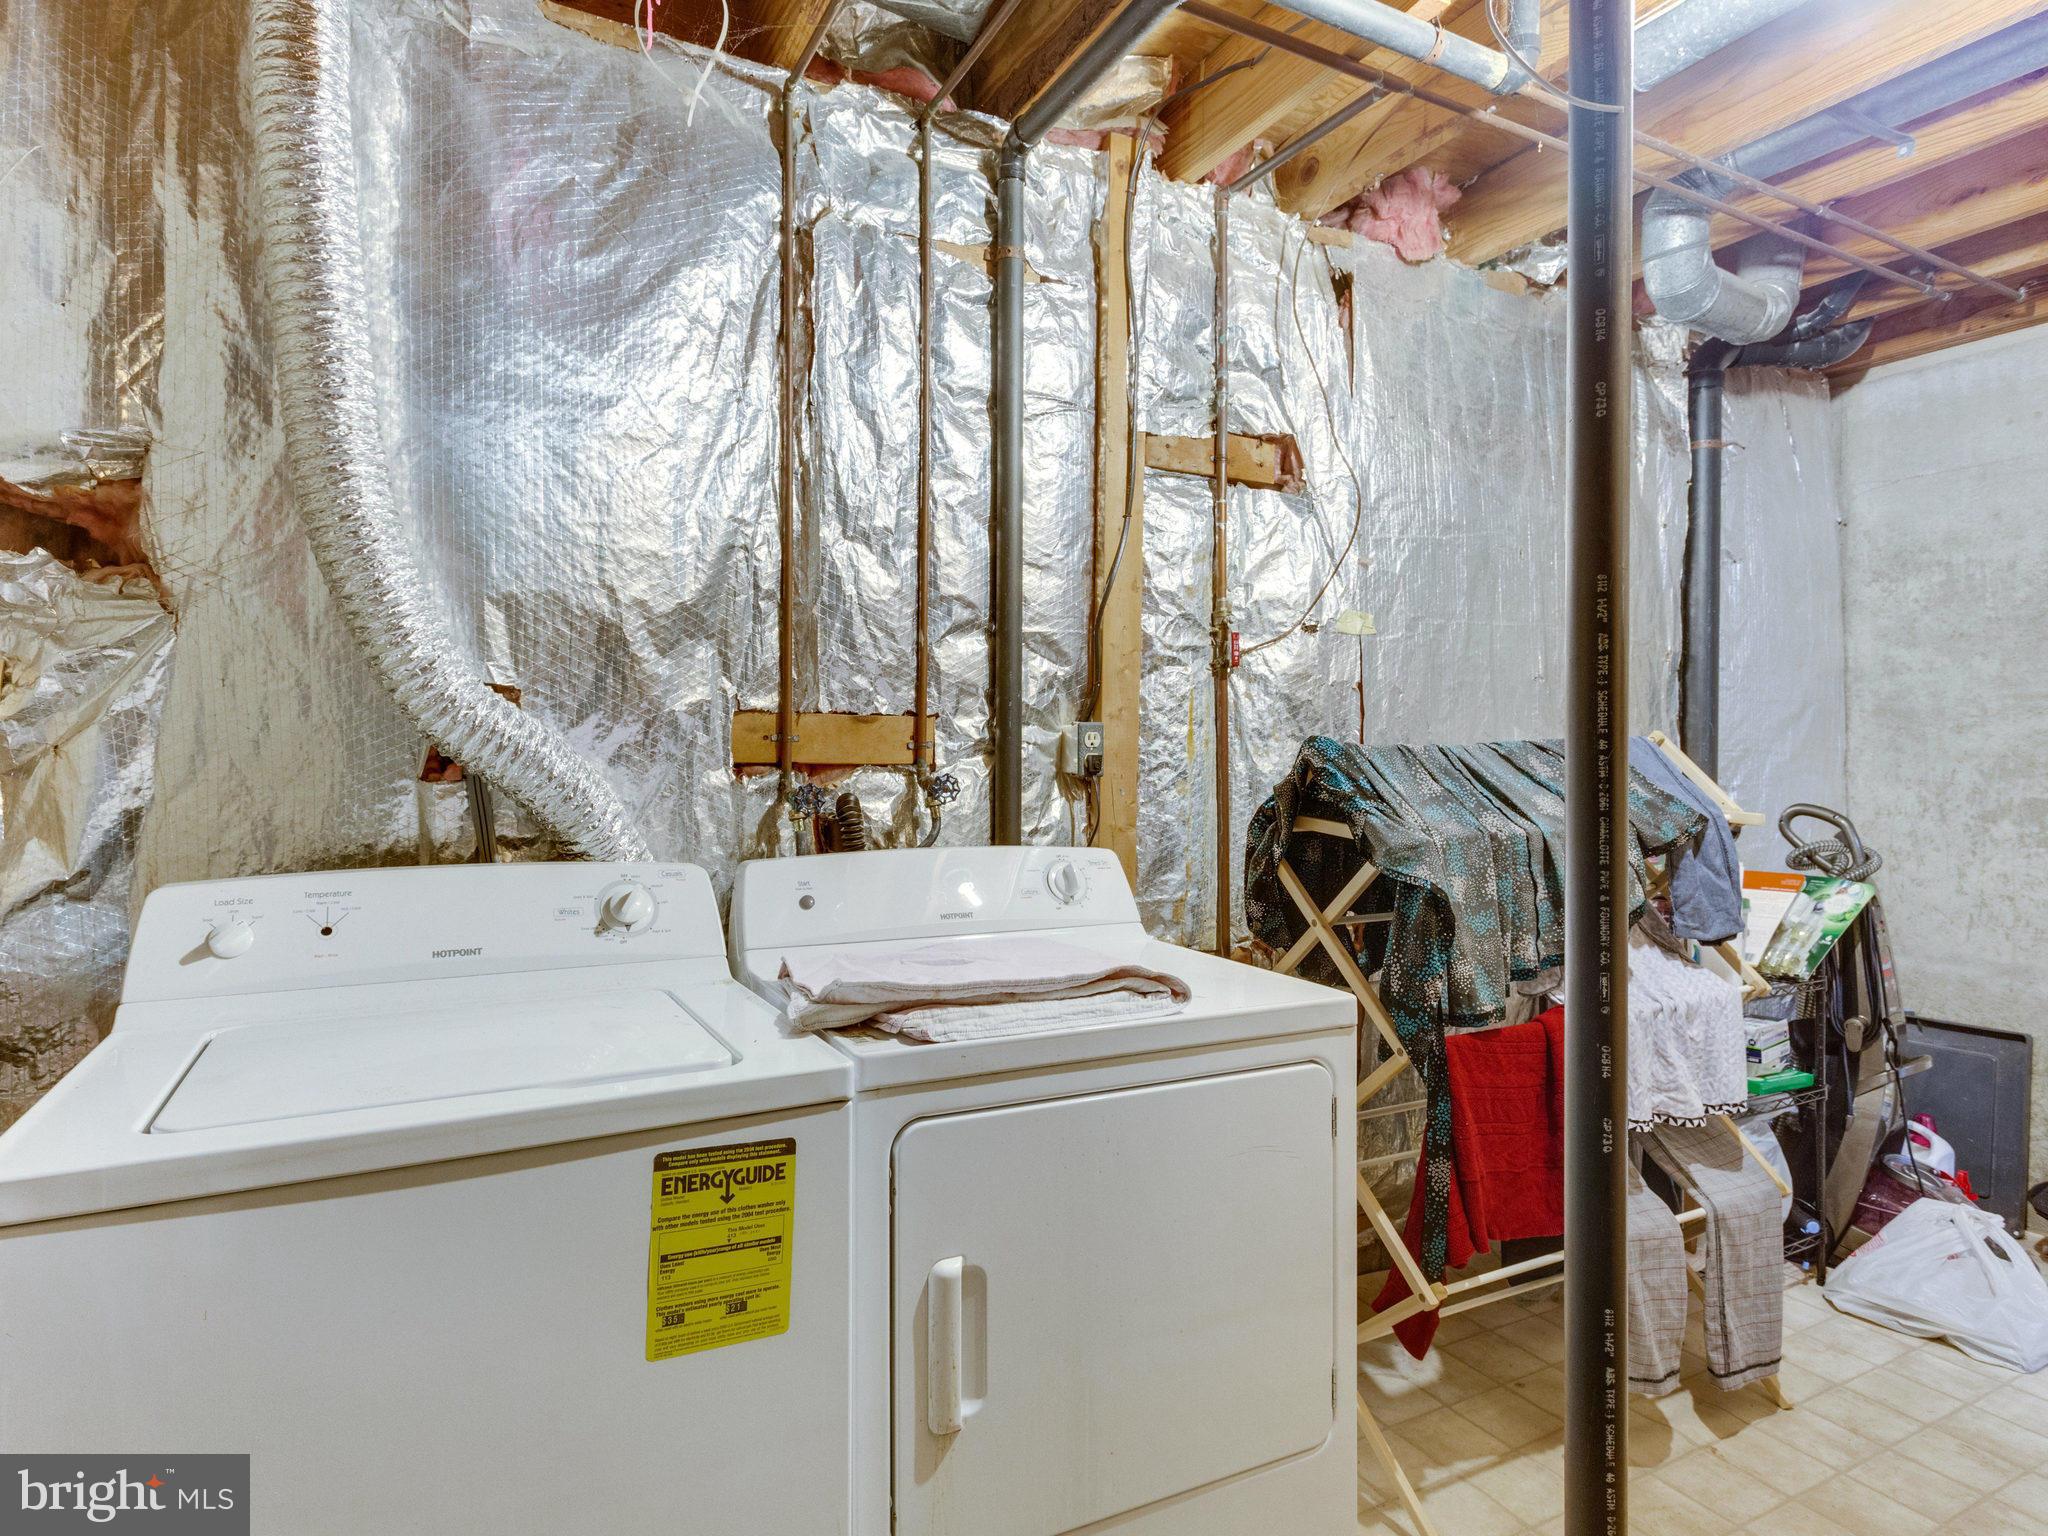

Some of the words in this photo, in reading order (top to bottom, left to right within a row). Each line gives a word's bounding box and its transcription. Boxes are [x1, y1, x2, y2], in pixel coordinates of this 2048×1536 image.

[1597, 690, 1609, 734] SCHEDULE
[1598, 817, 1610, 866] CHARLOTTE
[1599, 870, 1610, 890] PIPE
[304, 890, 352, 900] Temperature
[940, 911, 974, 921] HOTPOINT
[1599, 907, 1610, 947] FOUNDRY
[432, 947, 483, 958] HOTPOINT
[661, 1162, 787, 1197] ENERGYGUIDE
[657, 1214, 680, 1224] Compare
[691, 1211, 708, 1219] energy
[737, 1203, 756, 1211] clothes
[1604, 1424, 1616, 1467] SCHEDULE
